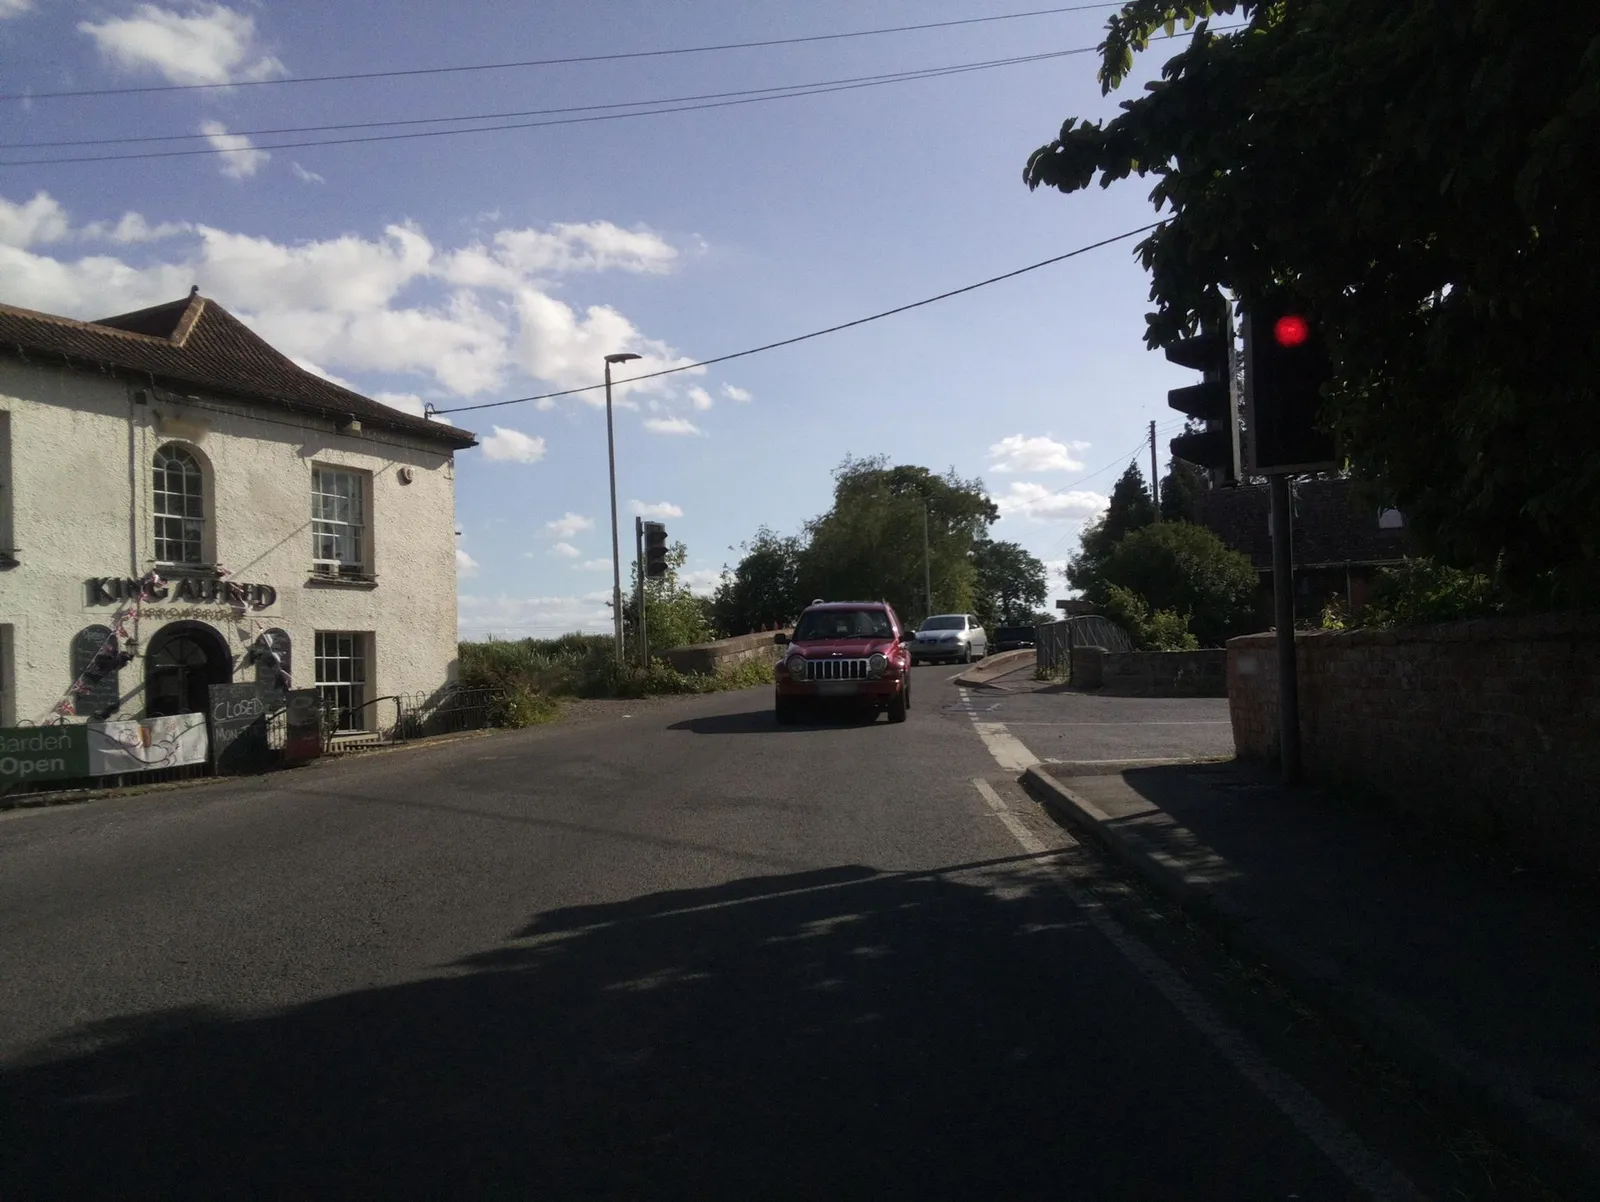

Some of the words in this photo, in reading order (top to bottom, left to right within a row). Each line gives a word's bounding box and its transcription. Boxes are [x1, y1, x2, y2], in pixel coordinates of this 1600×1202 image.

[84, 577, 169, 605] KING
[172, 578, 277, 610] ALFRED
[213, 697, 264, 721] CLOSED
[0, 755, 65, 778] Open
